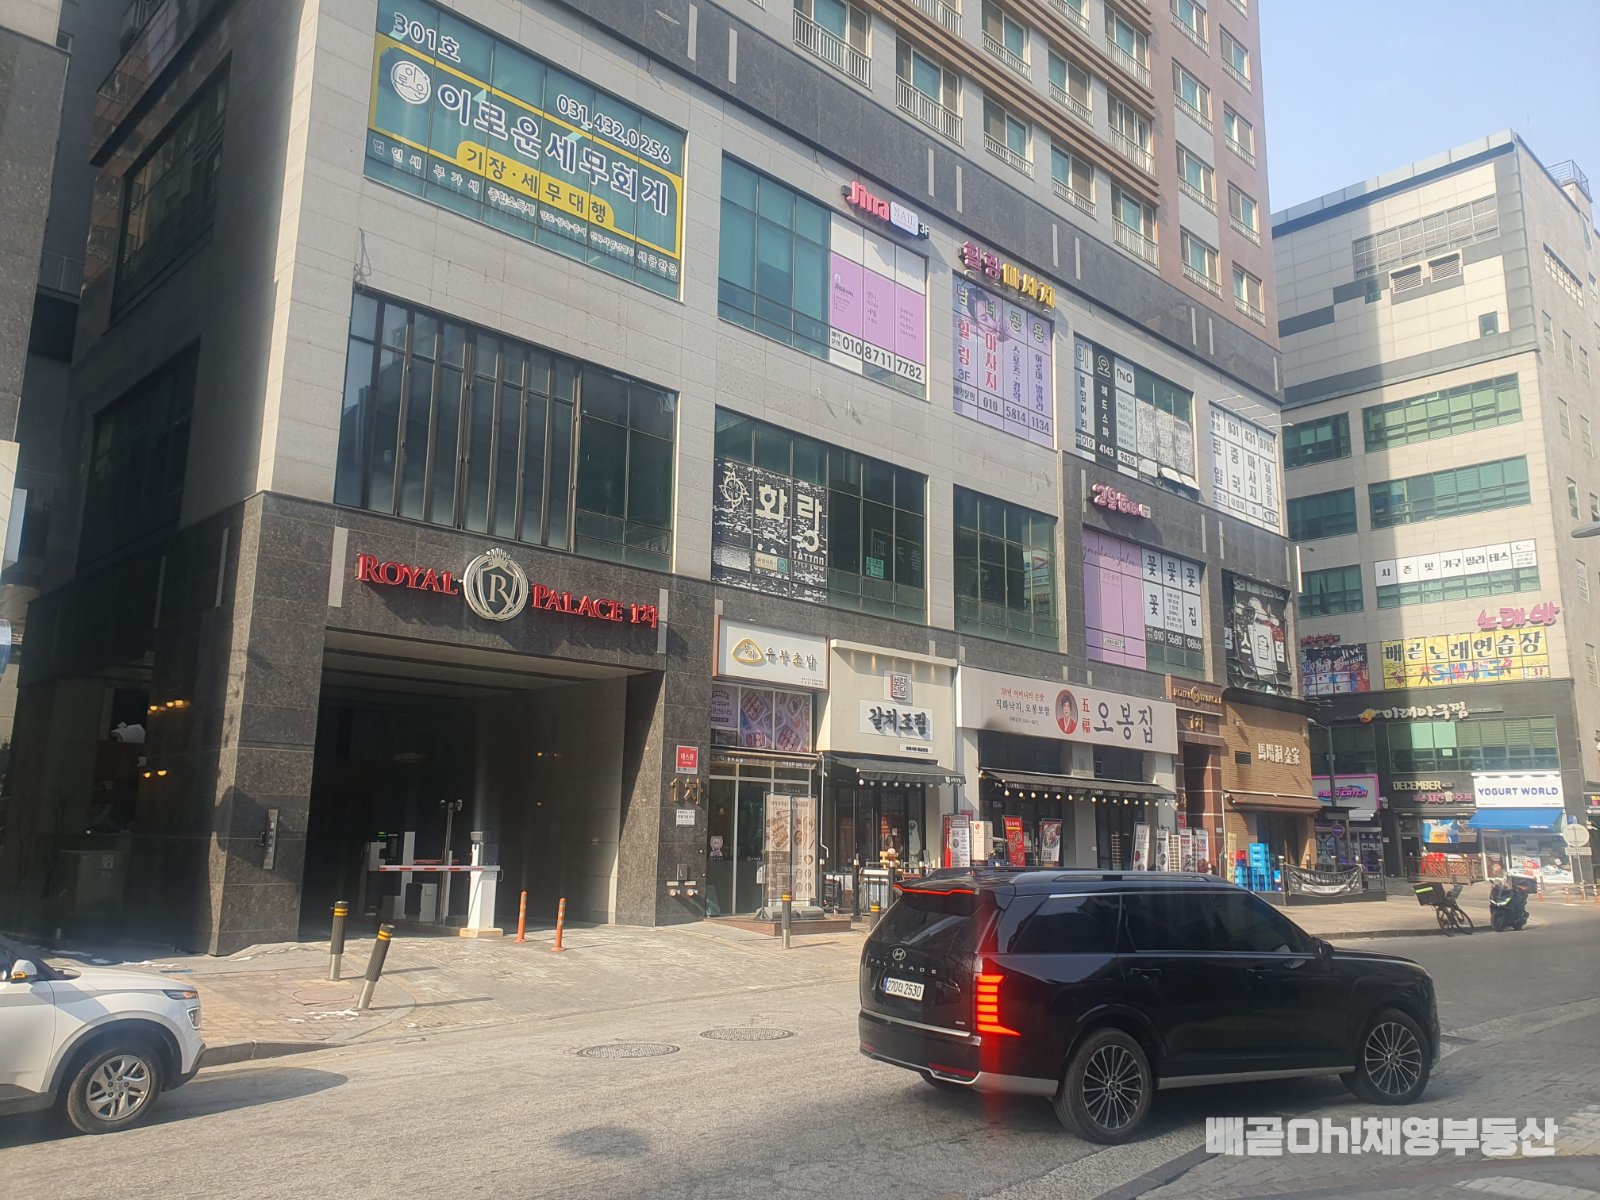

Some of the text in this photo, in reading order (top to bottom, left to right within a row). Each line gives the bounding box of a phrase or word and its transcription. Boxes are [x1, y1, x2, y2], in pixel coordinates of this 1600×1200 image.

[394, 12, 462, 63] 301호
[556, 94, 672, 165] 031.432.0256
[437, 83, 670, 215] 이로운세무회계
[372, 139, 422, 170] 법인세
[433, 165, 480, 194] 부가세
[487, 187, 535, 217] 종합소득세
[919, 221, 930, 236] 3F
[963, 241, 1056, 309] 힐링 마사지
[842, 336, 922, 381] 010 8711 7782
[957, 318, 970, 367] 힐링
[958, 367, 971, 382] 3F
[985, 332, 998, 393] 마사지
[983, 396, 998, 413] 010
[1006, 405, 1026, 424] 5814
[1031, 416, 1050, 433] 1134
[1100, 385, 1110, 438] 헤드스파
[1227, 421, 1239, 437] 031
[1244, 430, 1256, 446] 431
[1082, 437, 1094, 448] 010
[1099, 444, 1114, 457] 4143
[1120, 452, 1135, 466] 9420
[1247, 455, 1257, 501] 마사지
[755, 484, 825, 553] 화랑
[356, 552, 459, 597] ROYAL
[1147, 554, 1157, 577] 꽃
[1166, 561, 1176, 583] 꽃
[1186, 567, 1196, 589] 꽃
[1442, 555, 1462, 571] 기구
[1465, 551, 1510, 567] 필라테스
[486, 573, 516, 608] R
[531, 582, 659, 629] PALACE 1차
[1149, 594, 1159, 616] 꽃
[1188, 606, 1197, 627] 집
[1477, 602, 1560, 630] 노래방
[766, 647, 816, 668] 유부초밥
[1153, 630, 1165, 642] 010
[1167, 633, 1183, 647] 5680
[1187, 637, 1202, 650] 0866
[868, 706, 927, 736] 갈치조림
[1094, 702, 1154, 744] 오봉집
[671, 777, 703, 805] 1차
[1392, 780, 1442, 791] DECEMBER
[1478, 787, 1559, 796] YOGURT WORLD
[870, 958, 937, 975] PALISADE
[904, 983, 922, 998] 2530
